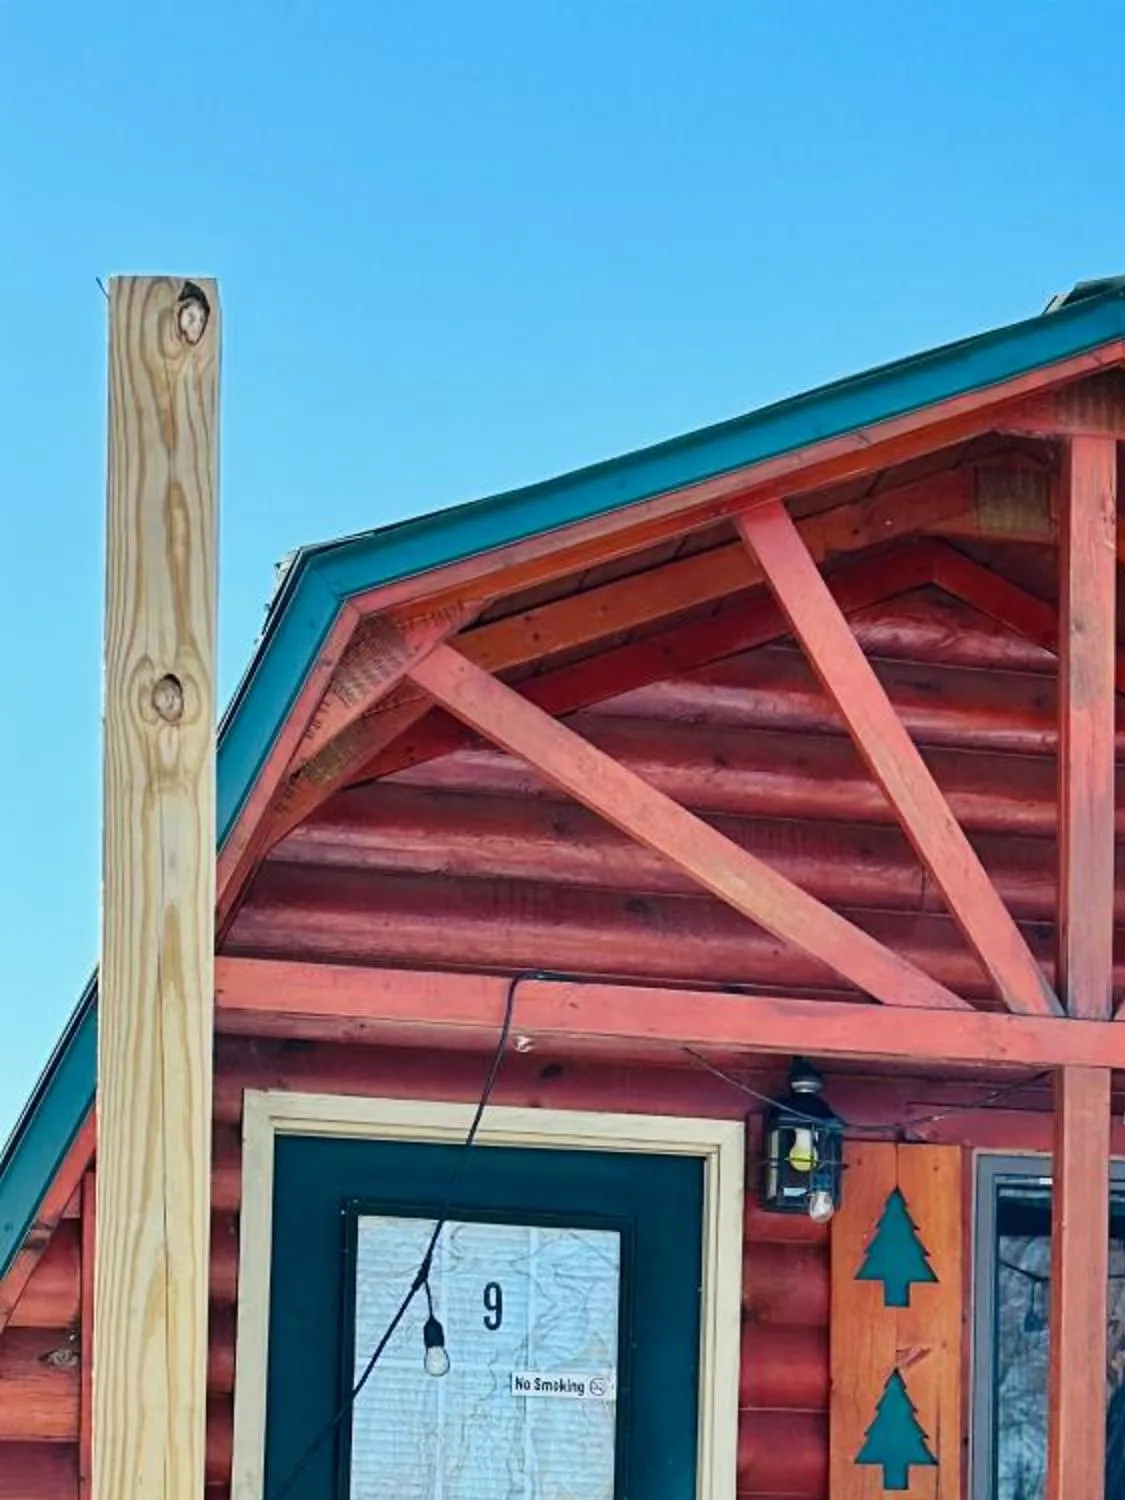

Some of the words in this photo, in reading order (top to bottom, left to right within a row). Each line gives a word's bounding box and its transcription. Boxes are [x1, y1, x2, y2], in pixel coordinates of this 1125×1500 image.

[483, 1281, 503, 1331] 9
[515, 1375, 530, 1391] No
[533, 1377, 585, 1396] Smoking
